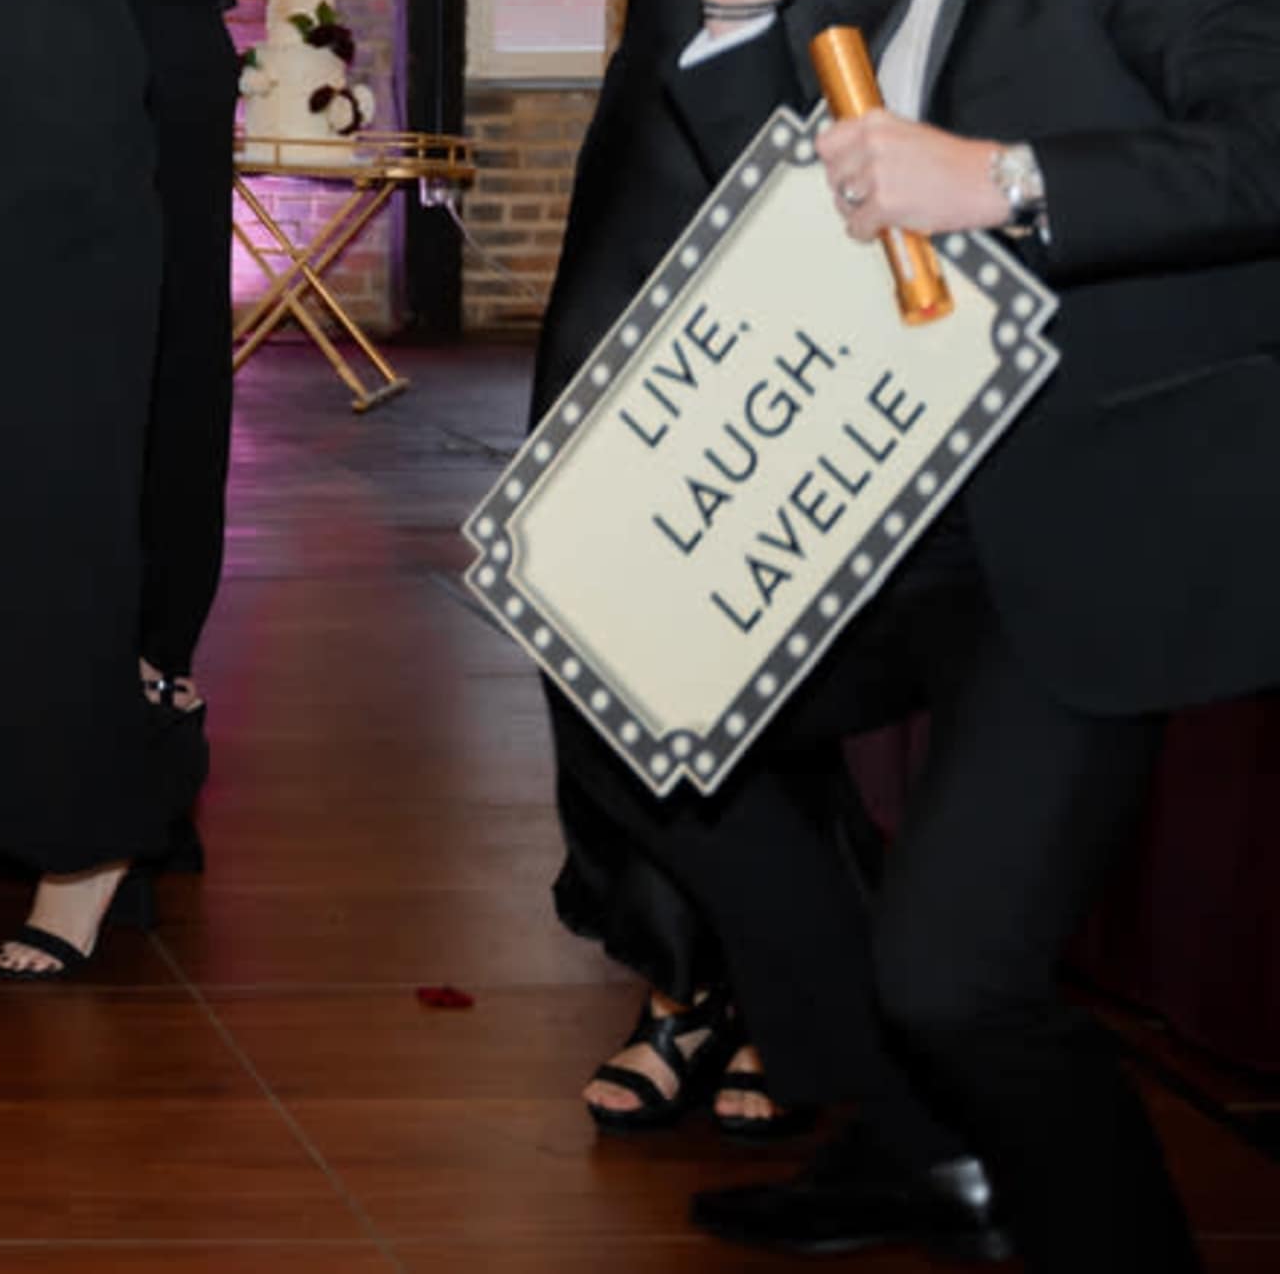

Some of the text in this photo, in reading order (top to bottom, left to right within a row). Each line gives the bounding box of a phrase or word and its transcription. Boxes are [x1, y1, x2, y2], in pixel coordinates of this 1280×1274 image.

[619, 301, 751, 449] LIVE.
[651, 329, 851, 555] LAUGH.
[710, 370, 927, 634] LAVELLE
